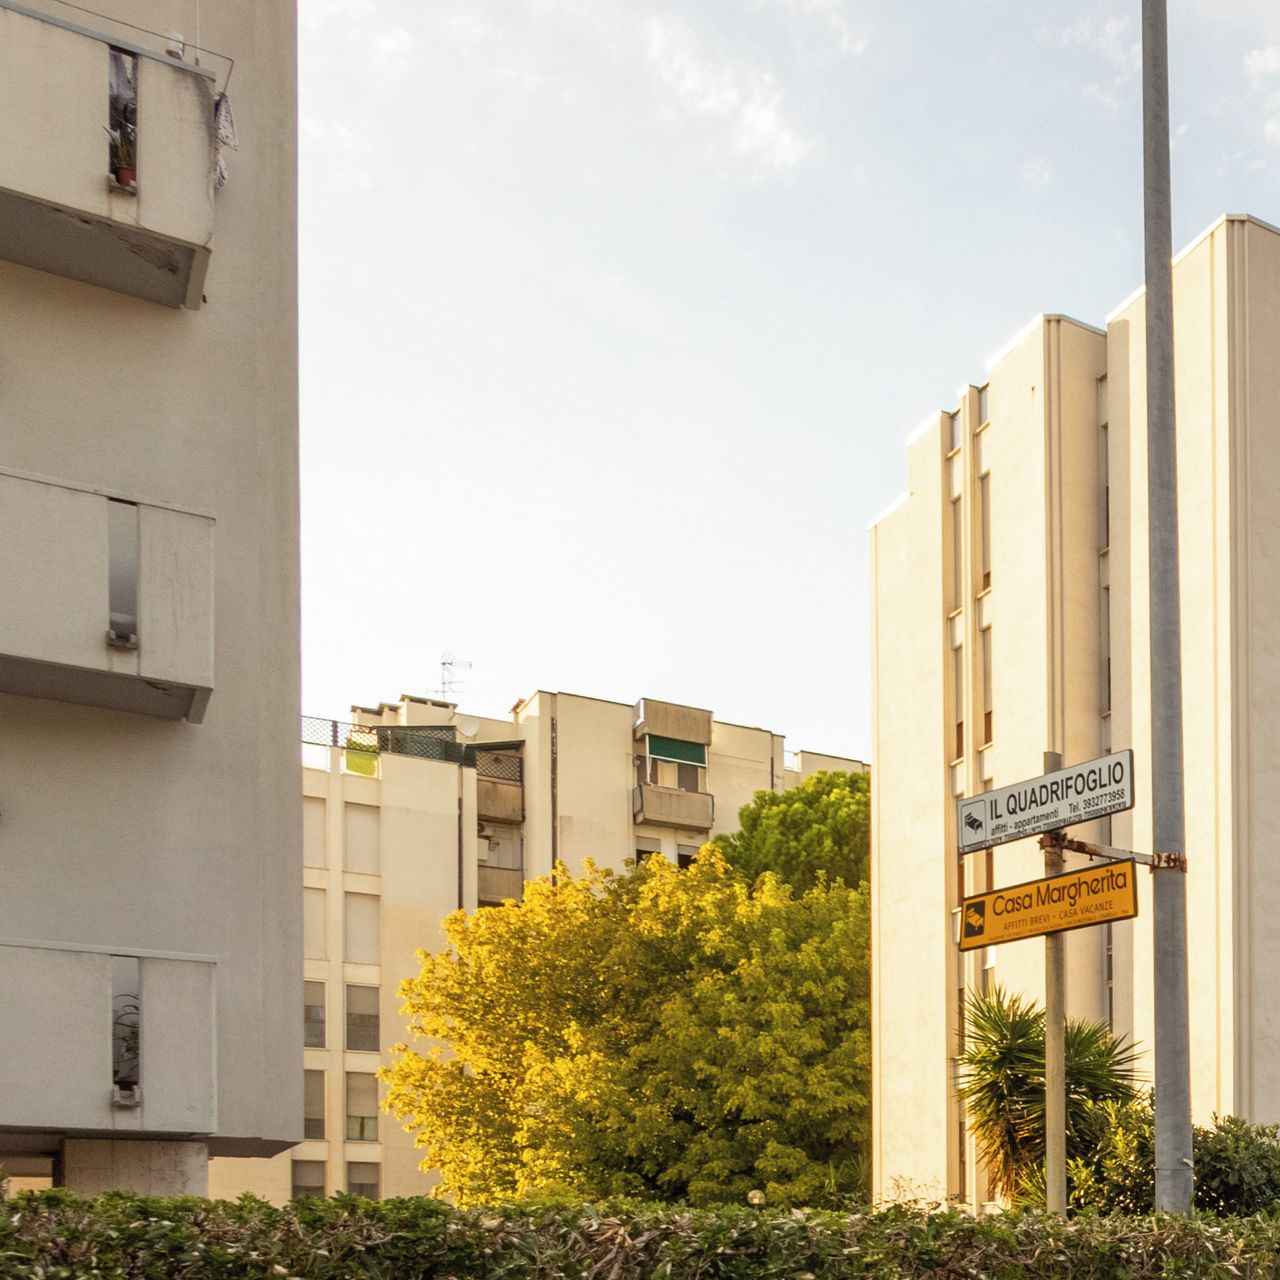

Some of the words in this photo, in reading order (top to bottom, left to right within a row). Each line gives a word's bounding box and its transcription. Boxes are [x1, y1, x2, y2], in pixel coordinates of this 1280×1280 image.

[990, 799, 1002, 820] IL
[1006, 761, 1124, 815] QUADRIFOGLIO
[1069, 802, 1080, 814] Tel.
[1082, 789, 1125, 810] 3932773958
[991, 822, 1008, 836] affitti
[1014, 808, 1059, 831] appartamenti
[993, 893, 1032, 916] Casa
[1036, 869, 1127, 907] Margherita
[1003, 918, 1028, 931] AFFITTI
[1030, 913, 1050, 926] BREVI
[1059, 908, 1078, 920] CASA
[1080, 900, 1113, 915] VACANZE
